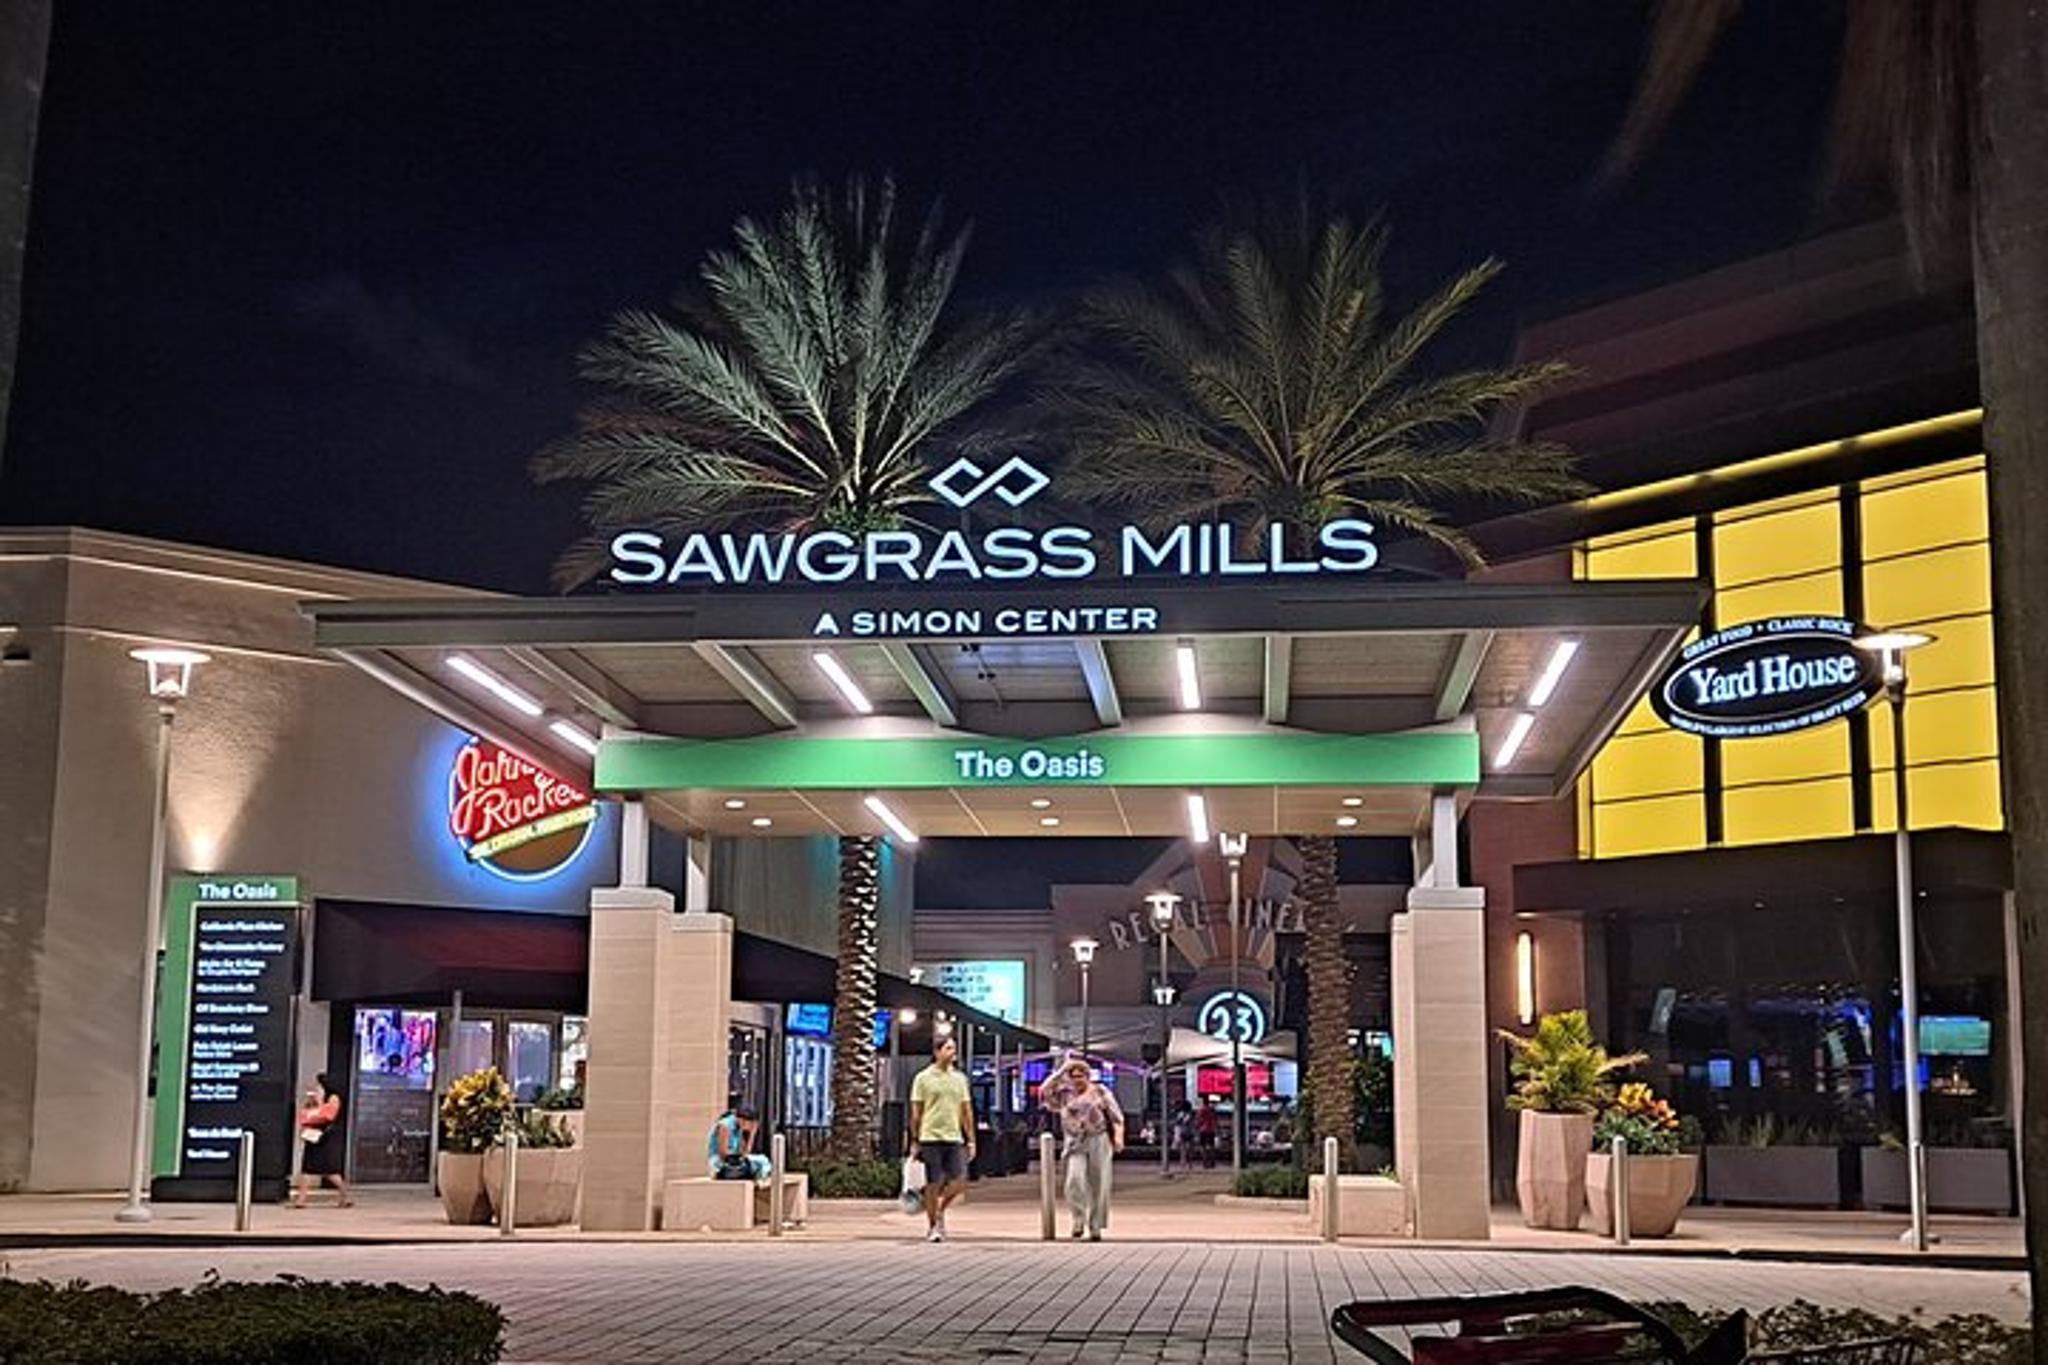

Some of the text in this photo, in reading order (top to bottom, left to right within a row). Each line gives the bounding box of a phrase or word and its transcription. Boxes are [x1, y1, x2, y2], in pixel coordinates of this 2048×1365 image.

[610, 519, 1378, 584] SAWGRASS MILLS
[814, 608, 1157, 635] A SIMON CENTER
[1690, 655, 1856, 704] Yard House
[955, 750, 1104, 777] The Oasis
[198, 882, 278, 899] The Oasis
[1211, 1005, 1253, 1042] 23
